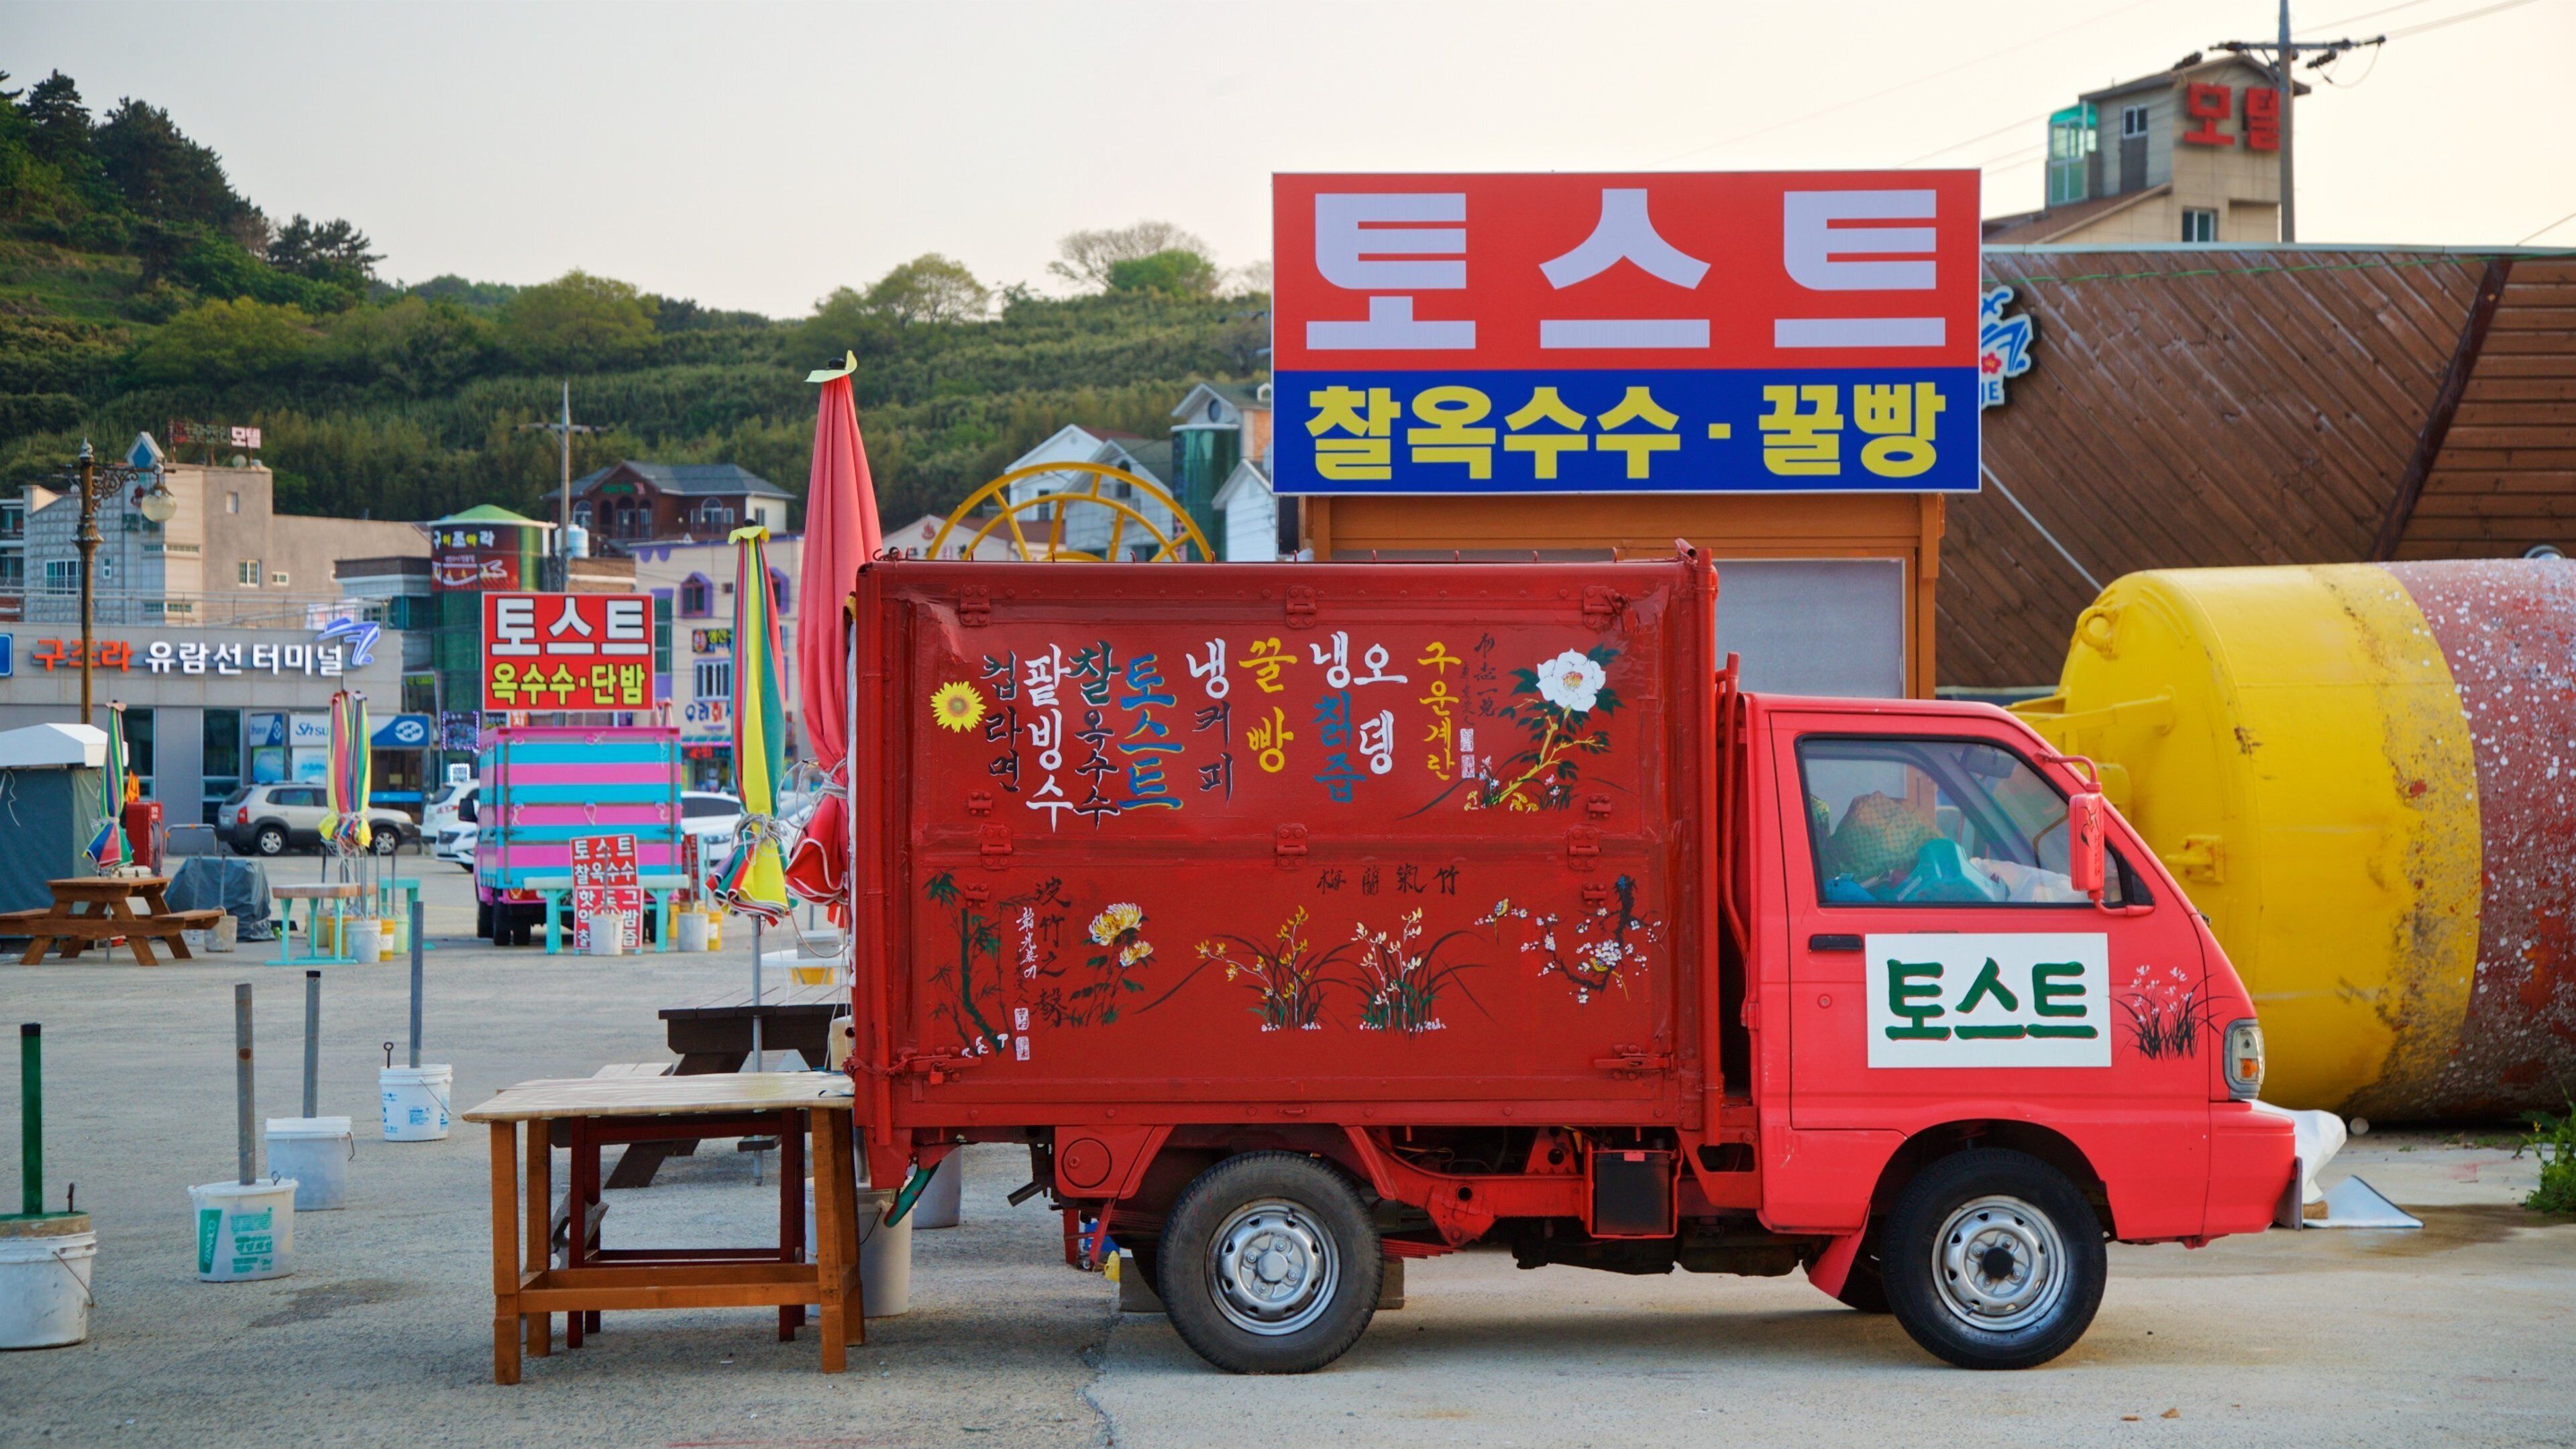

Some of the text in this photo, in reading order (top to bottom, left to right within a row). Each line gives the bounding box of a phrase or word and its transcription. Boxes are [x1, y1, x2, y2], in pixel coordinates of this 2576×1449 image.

[1305, 188, 1946, 350] 토스트
[1304, 381, 1947, 480] 찰옥수수 꿀빵
[34, 639, 343, 676] 구조라 유람선 터미널
[490, 596, 649, 655] 토스트
[491, 662, 646, 705] 옥수수 단밤
[980, 649, 1024, 792] 컵라면
[1023, 643, 1074, 833] 팥빙수
[1069, 639, 1122, 831] 찰옥수수
[1117, 652, 1185, 810] 토스트
[1185, 637, 1232, 808] 냉커피
[1238, 637, 1297, 773] 꿀빵
[1309, 631, 1366, 804] 냉칡즙
[1353, 643, 1408, 775] 오뎅
[1417, 641, 1461, 781] 구운계란
[574, 837, 633, 860] 토스트
[574, 860, 635, 885] 찰옥수수
[1884, 956, 2098, 1040] 토스트
